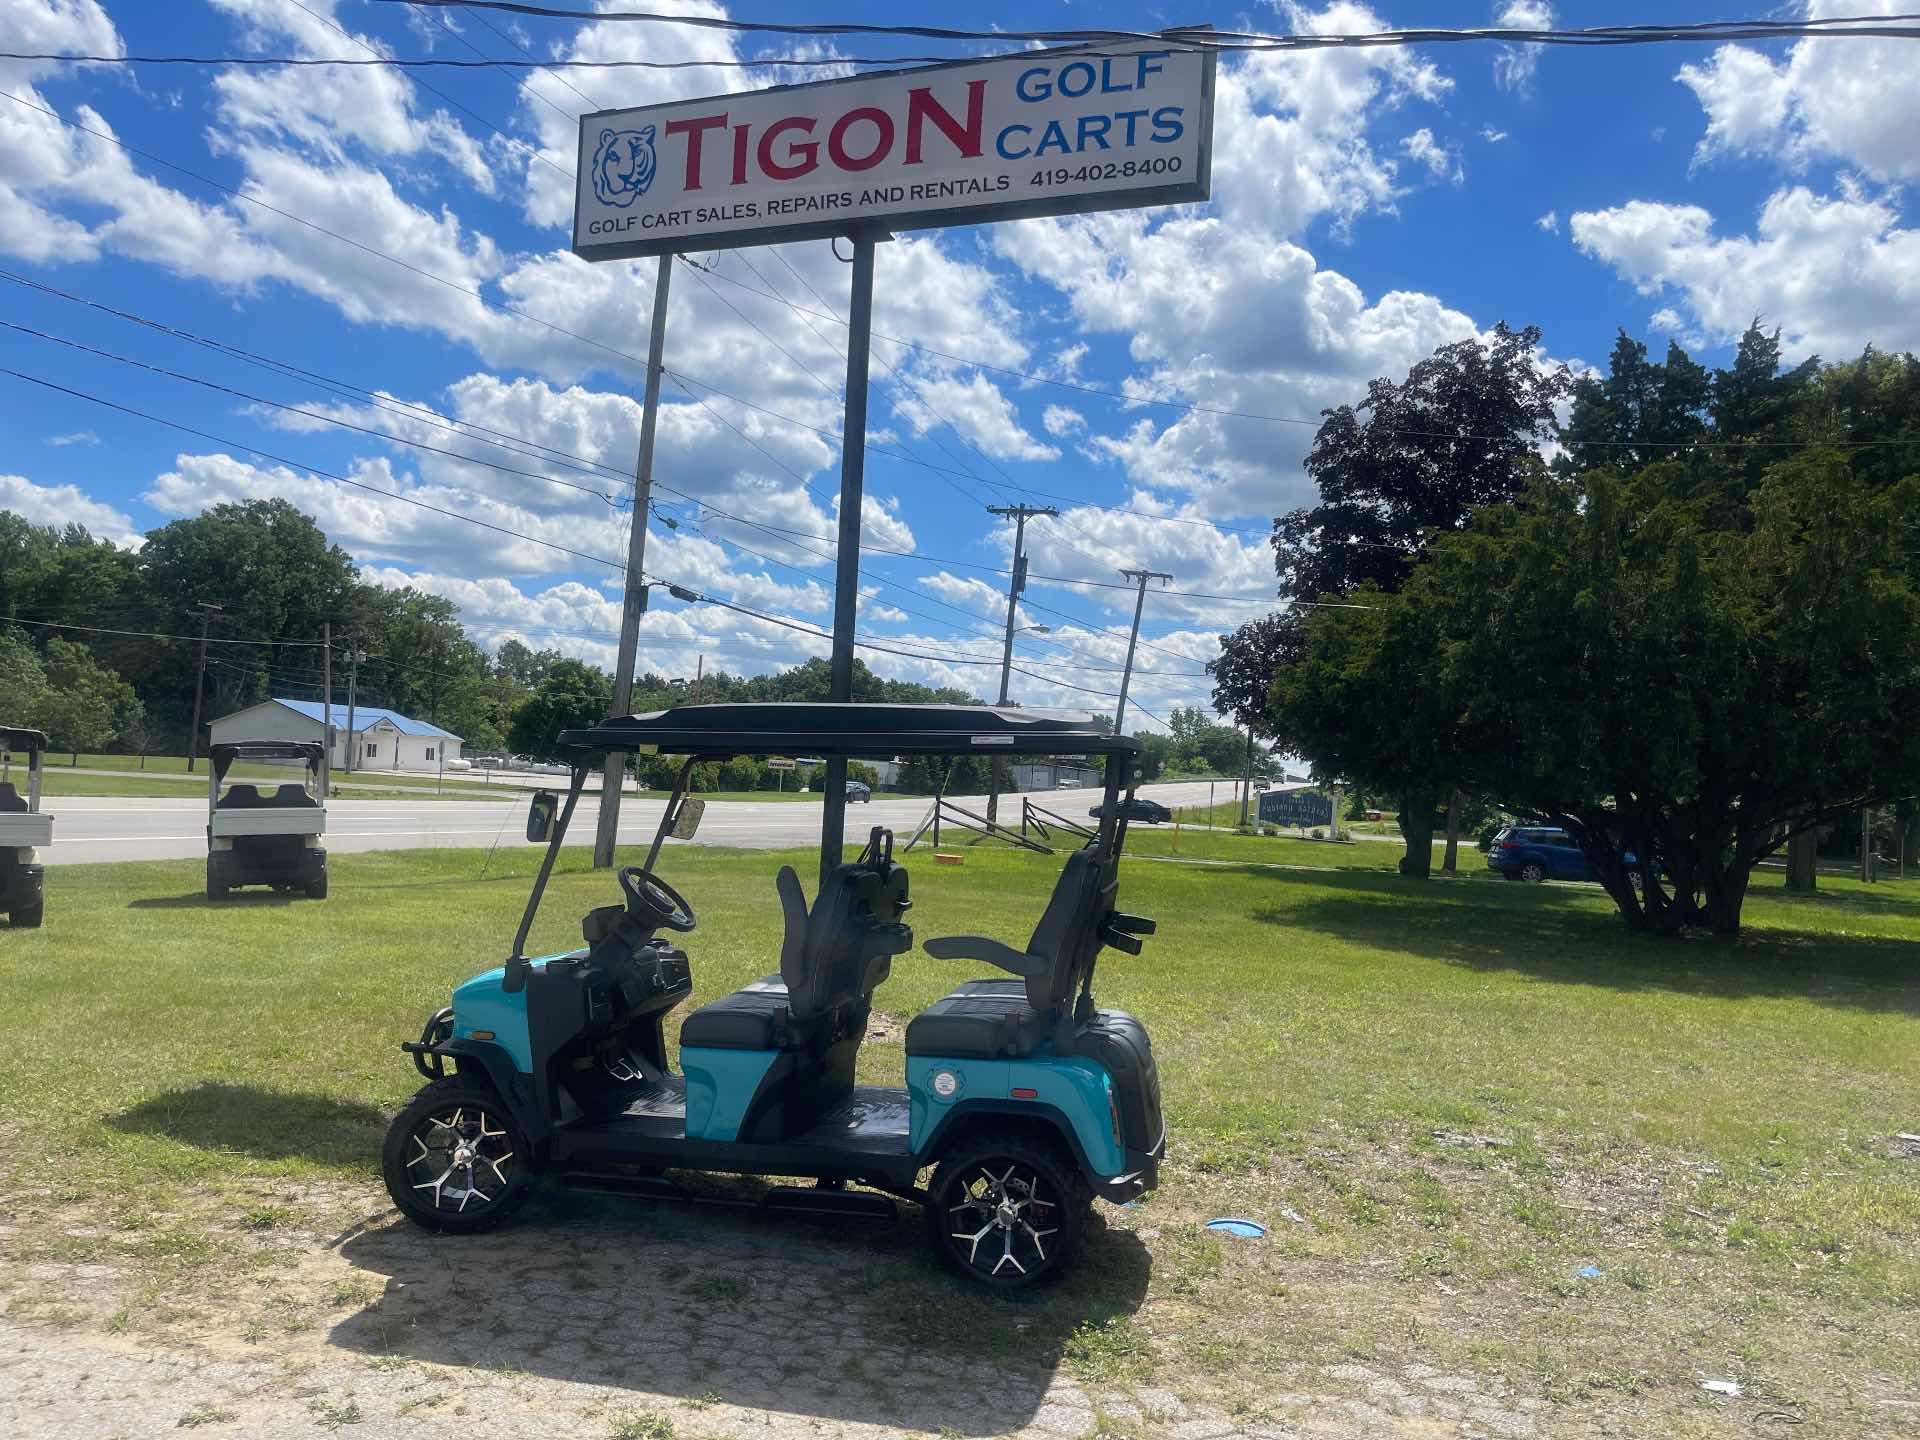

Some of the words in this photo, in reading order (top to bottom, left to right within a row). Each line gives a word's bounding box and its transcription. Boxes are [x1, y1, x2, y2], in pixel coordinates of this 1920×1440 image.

[1016, 52, 1170, 103] GOLF
[665, 80, 988, 191] TIGON
[996, 107, 1184, 160] CARTS
[1030, 156, 1182, 187] 419-402-8400
[589, 216, 638, 234] GOLF
[641, 210, 692, 229] CART
[696, 203, 762, 223] SALES,
[768, 192, 852, 215] REPAIRS
[859, 186, 904, 206] AND
[910, 175, 1010, 200] RENTALS
